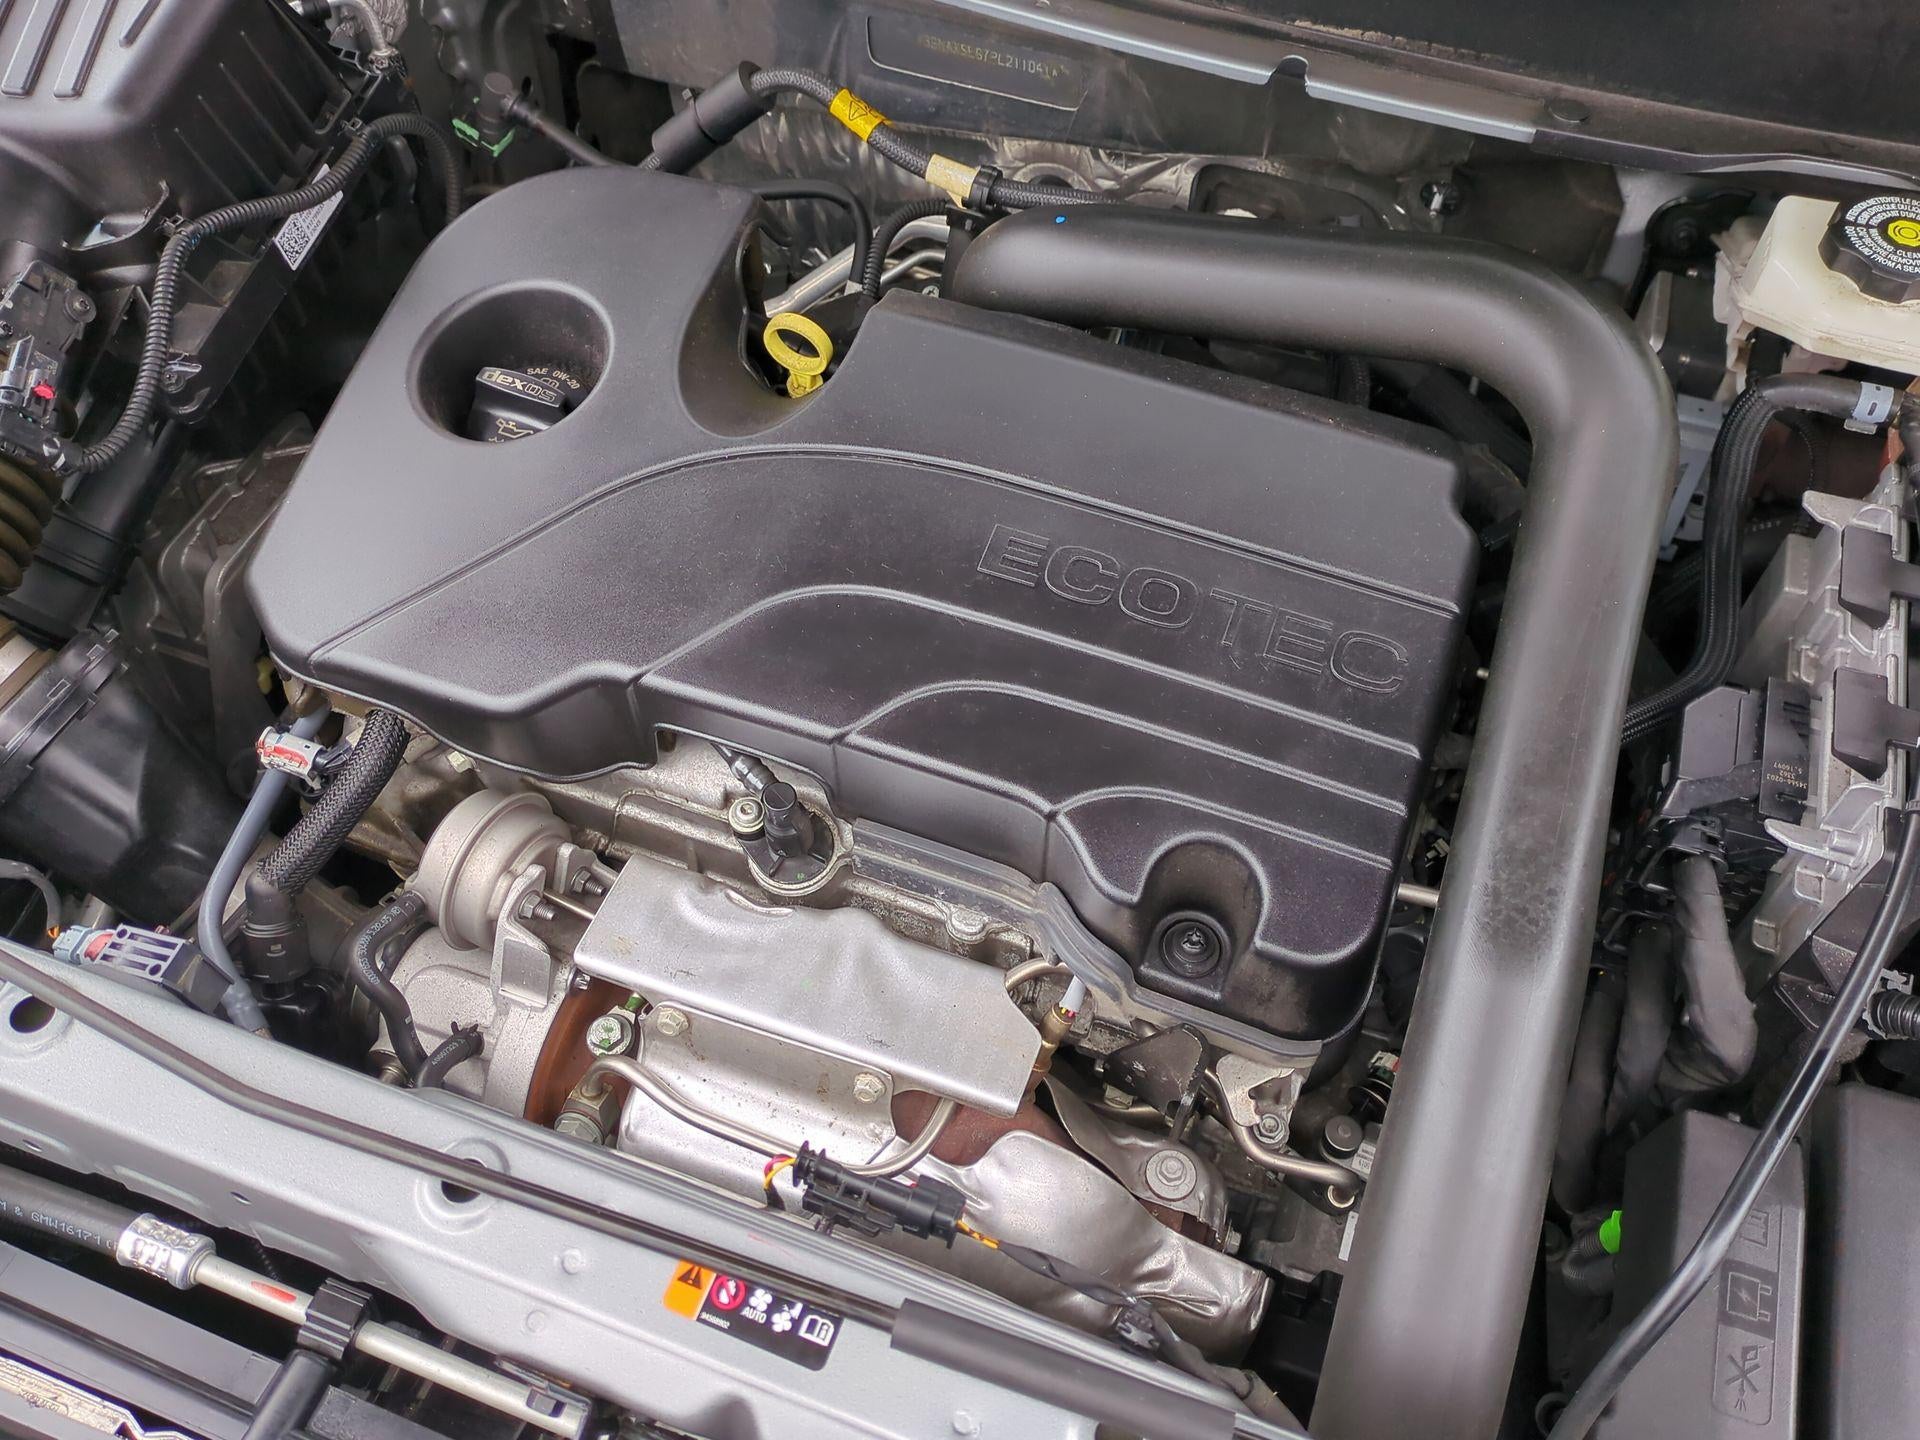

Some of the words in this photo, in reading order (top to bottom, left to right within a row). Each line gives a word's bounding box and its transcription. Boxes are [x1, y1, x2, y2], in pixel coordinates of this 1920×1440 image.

[1852, 240, 1873, 256] FLUID
[1871, 253, 1894, 267] FROM
[1862, 237, 1889, 257] BEFORE
[482, 370, 558, 403] dexos
[526, 367, 548, 375] SAE
[552, 370, 580, 390] 0W-20
[977, 524, 1408, 693] ECOTEC
[31, 1211, 101, 1245] GMW16171
[740, 1306, 767, 1324] AUTO
